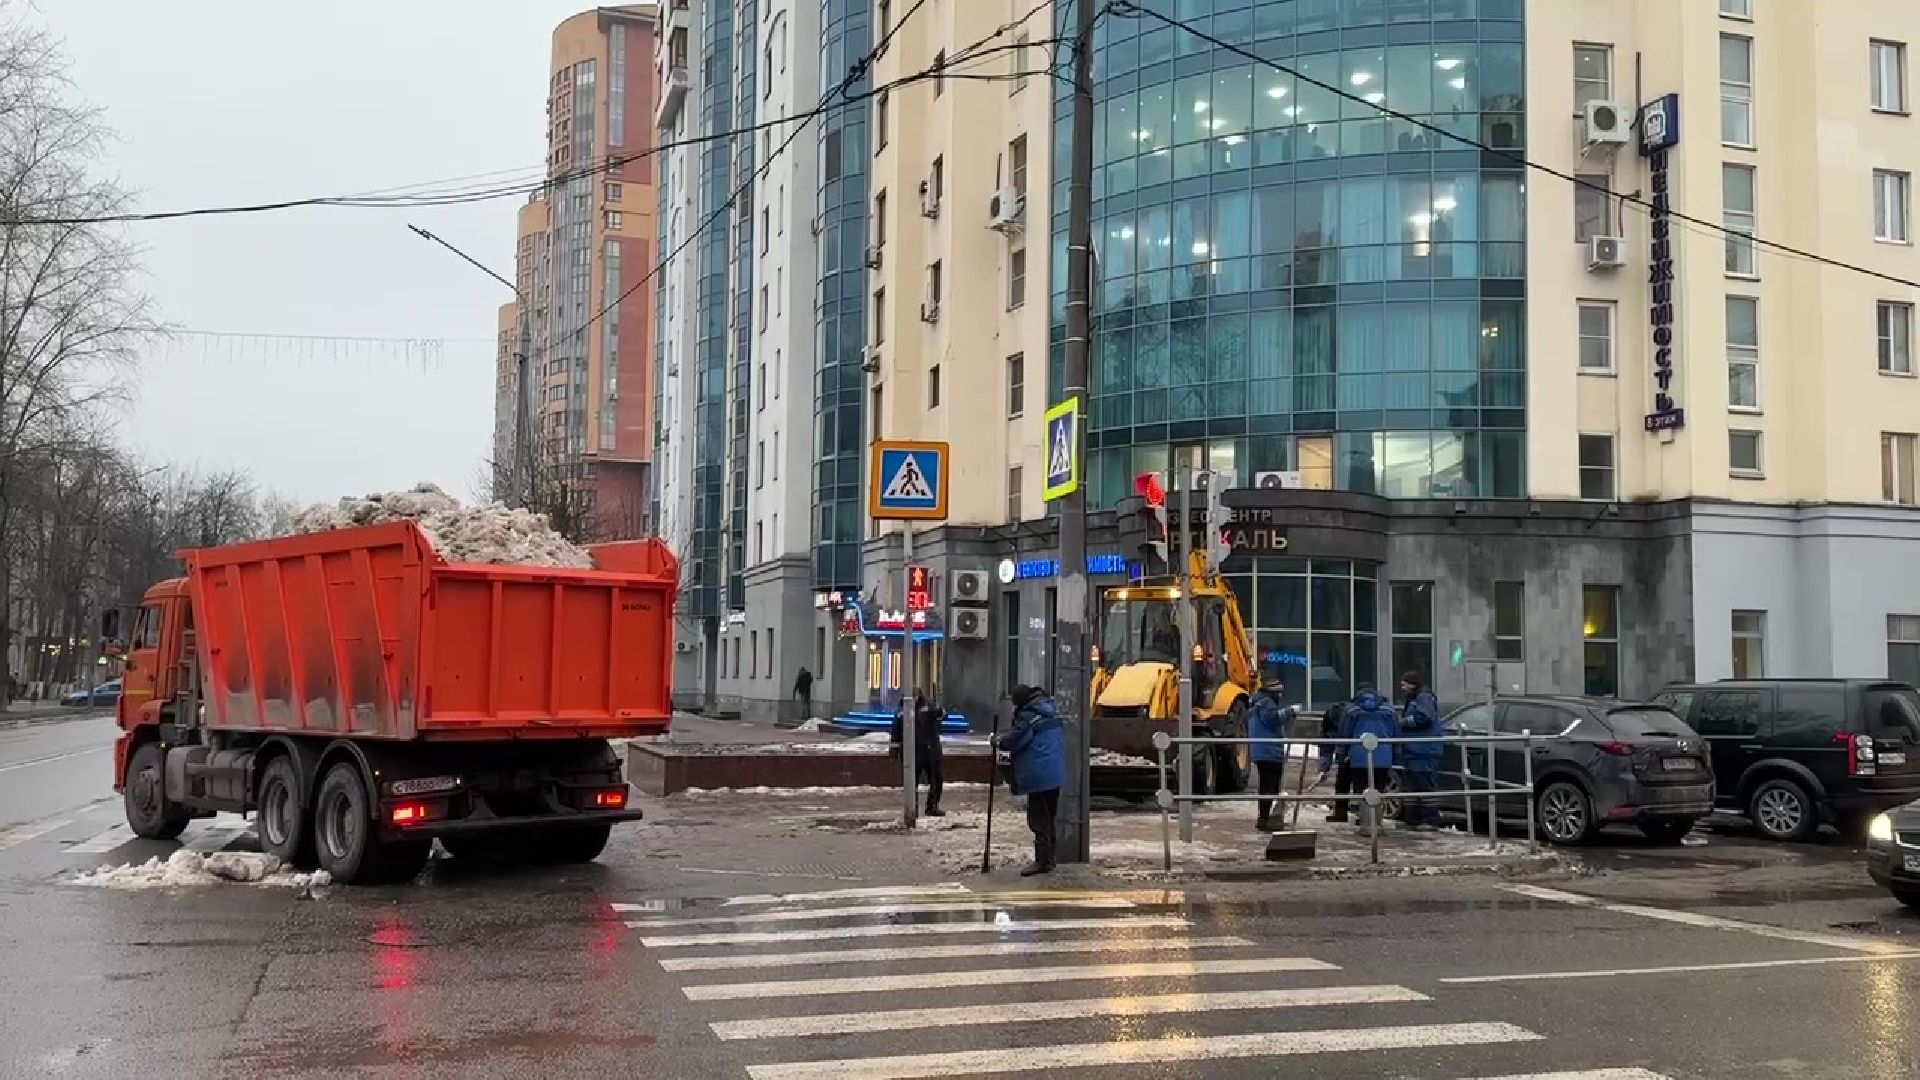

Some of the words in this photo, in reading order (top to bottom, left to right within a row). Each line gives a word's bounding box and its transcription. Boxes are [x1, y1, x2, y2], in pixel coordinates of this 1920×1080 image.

[1649, 150, 1674, 412] НЕДВИЖИМОСТЬ
[1169, 529, 1288, 551] РТИКАЛЬ
[909, 591, 928, 609] 30
